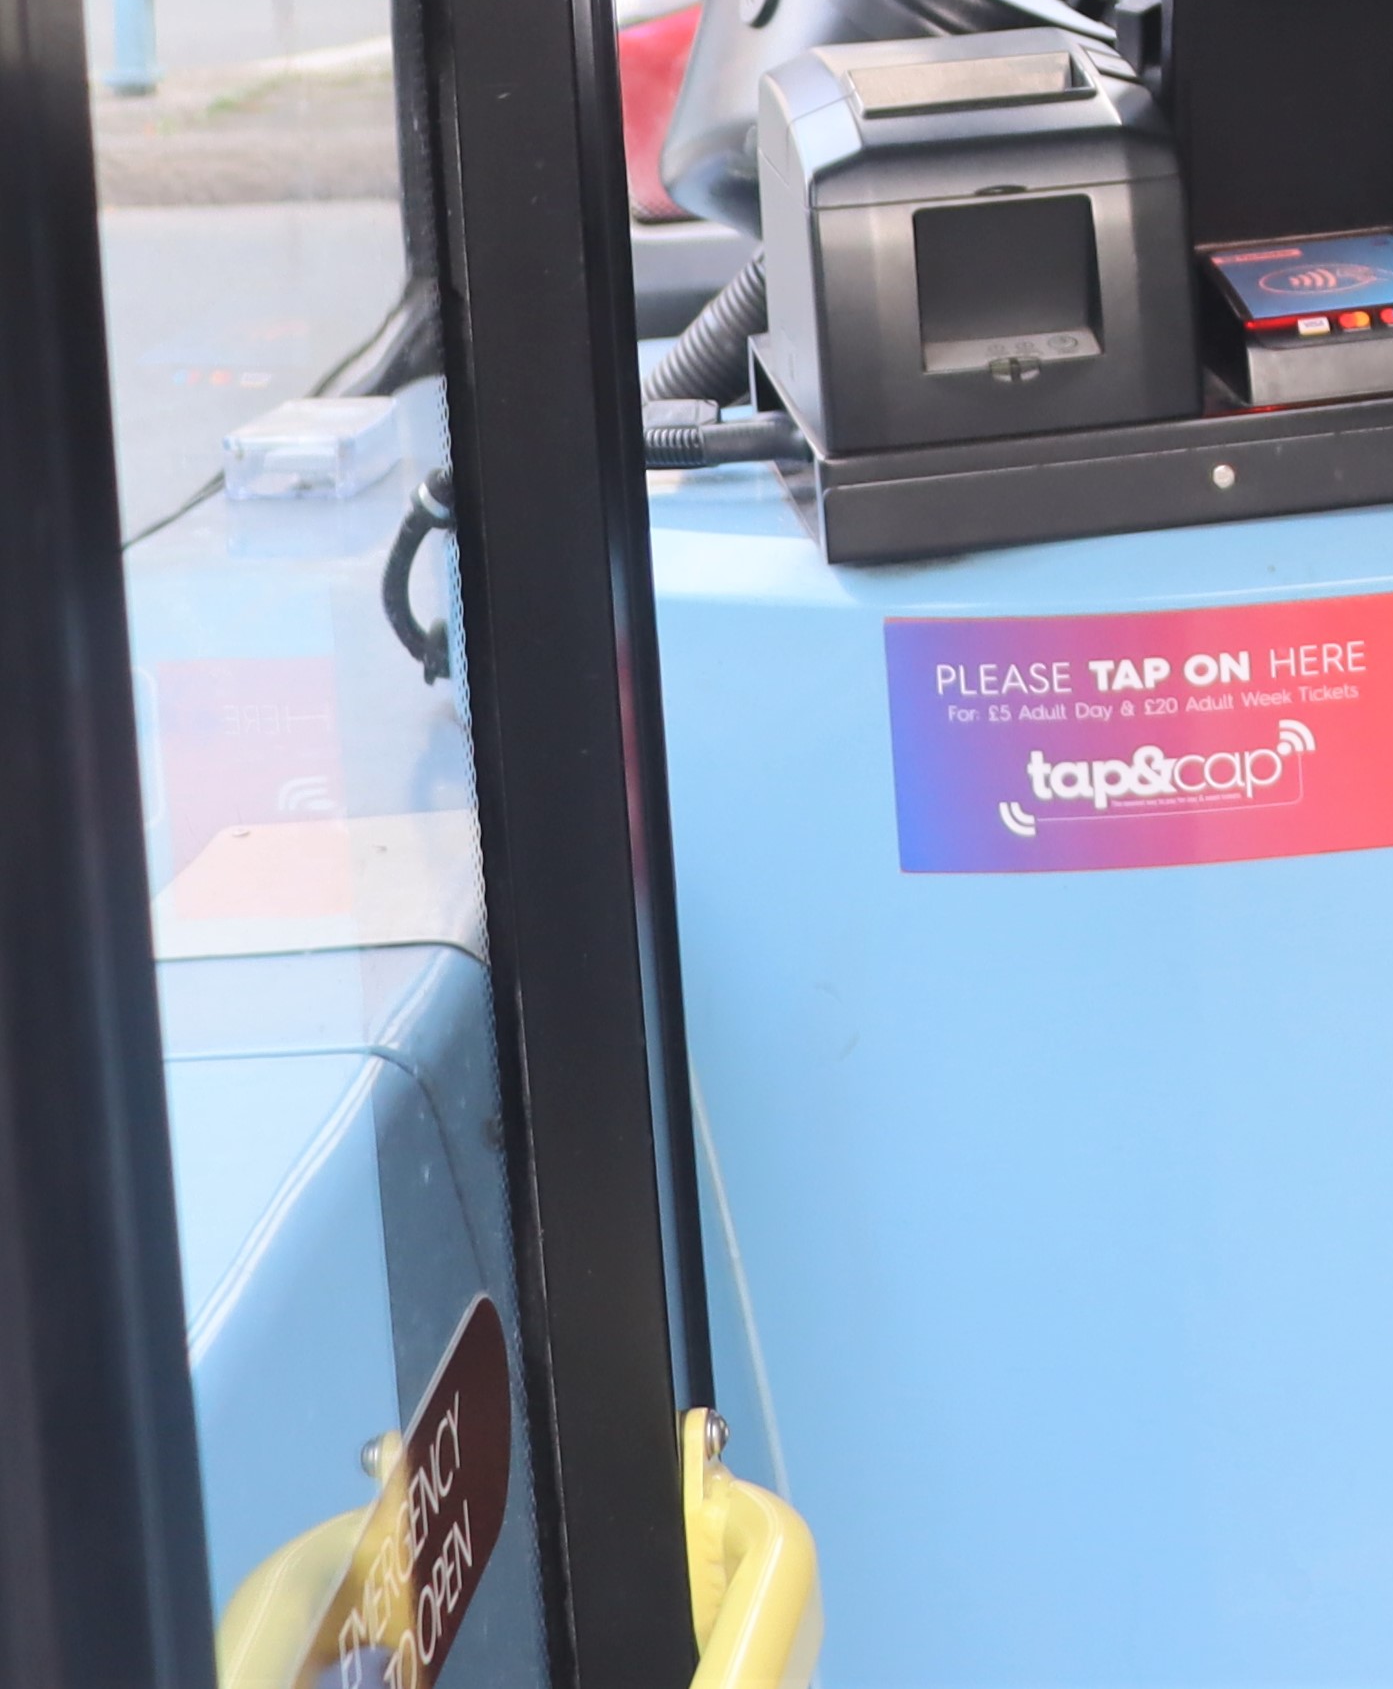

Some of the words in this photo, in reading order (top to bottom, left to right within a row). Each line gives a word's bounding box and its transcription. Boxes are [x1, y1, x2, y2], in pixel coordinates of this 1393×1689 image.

[936, 661, 1072, 696] PLEASE
[1089, 657, 1170, 692] TAP
[1184, 650, 1250, 686] ON
[1269, 640, 1367, 678] HERE
[988, 703, 1012, 722] £5
[1018, 702, 1067, 721] Adult
[1075, 701, 1113, 722] Day
[1120, 700, 1136, 716] &
[1144, 698, 1179, 715] £20
[1185, 694, 1235, 713] Adult
[1240, 688, 1292, 708] Week
[1299, 682, 1359, 701] Tickets
[1027, 745, 1283, 809] tap&cap
[338, 1390, 461, 1689] EMERGENCY
[417, 1499, 473, 1665] OPEN
